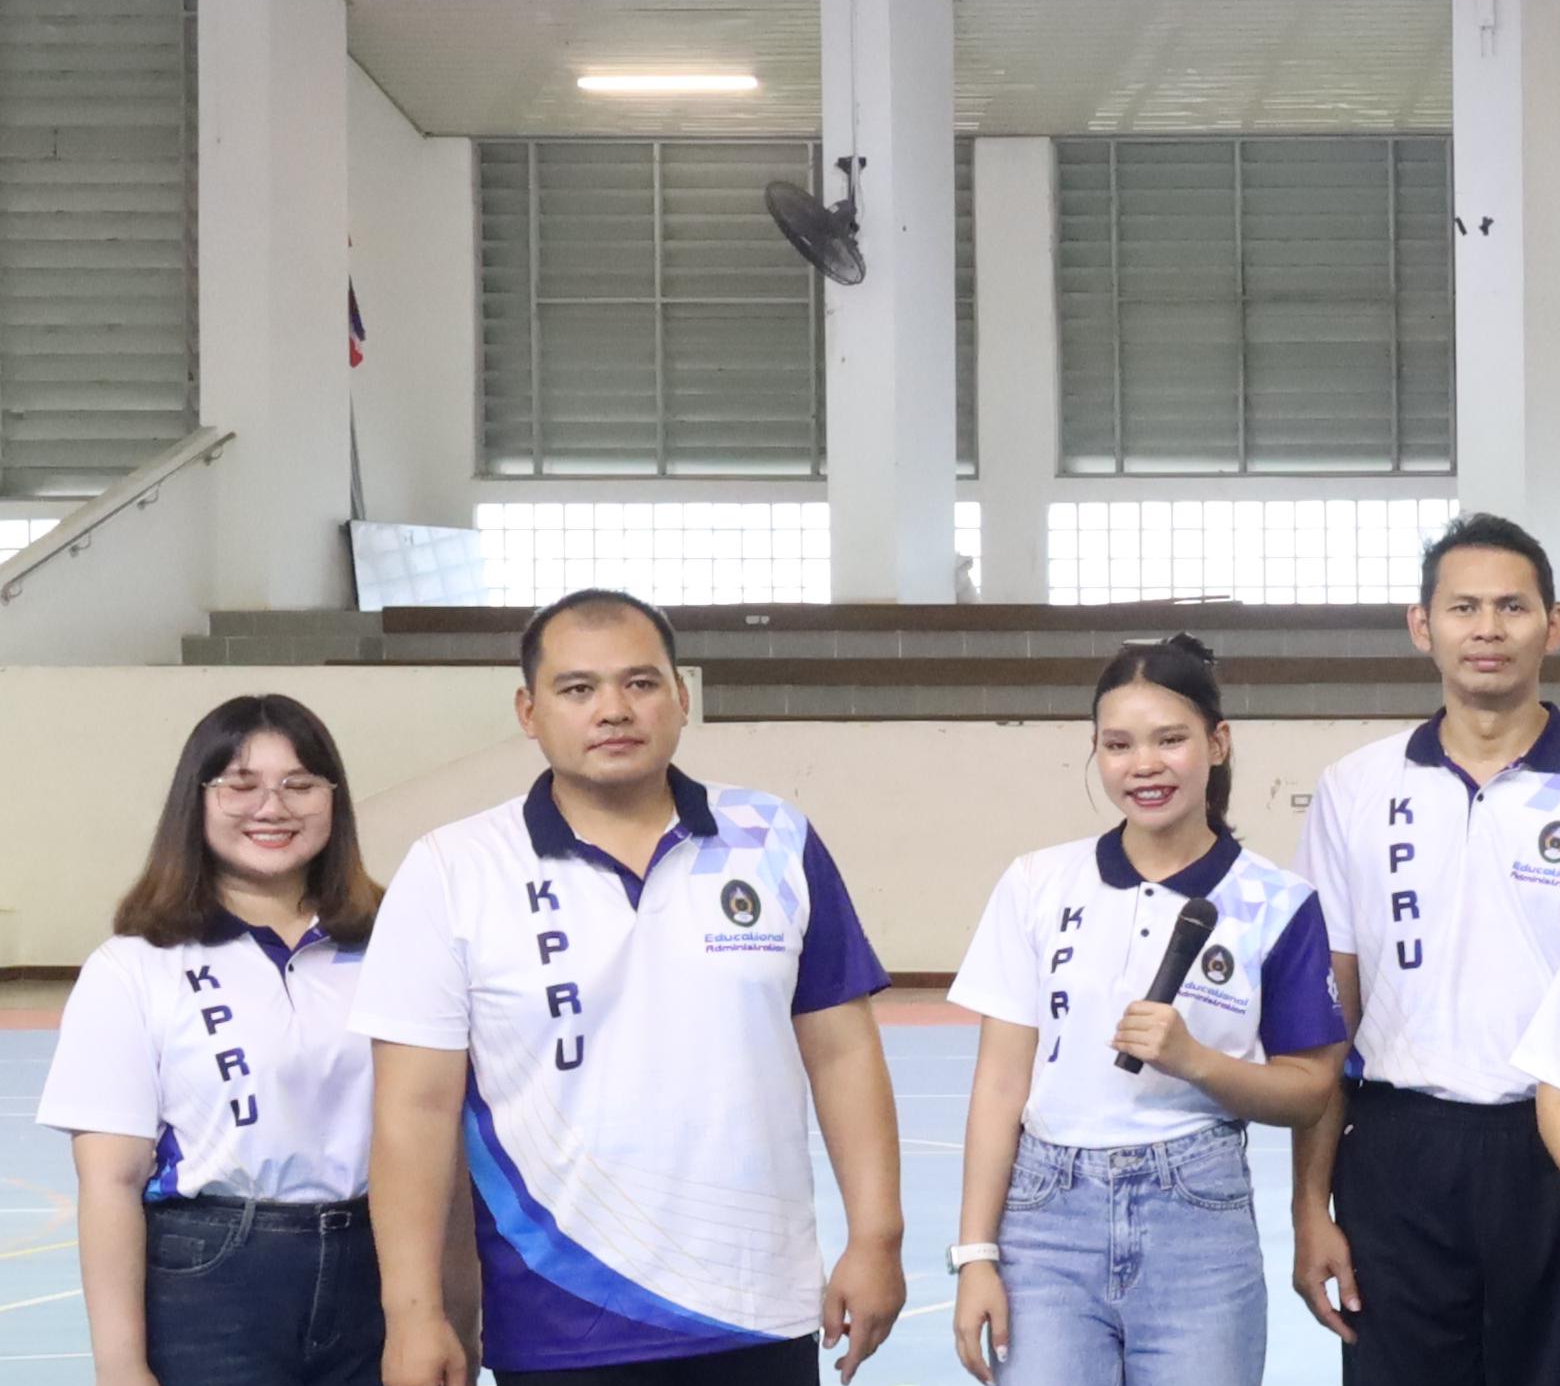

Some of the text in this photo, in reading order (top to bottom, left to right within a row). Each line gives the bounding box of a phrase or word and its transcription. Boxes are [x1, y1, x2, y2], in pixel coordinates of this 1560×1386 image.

[704, 932, 784, 943] Educational
[1388, 797, 1423, 970] KPRU
[185, 965, 259, 1127] KPRU
[526, 880, 585, 1071] KPRU
[1182, 981, 1249, 1007] ducational
